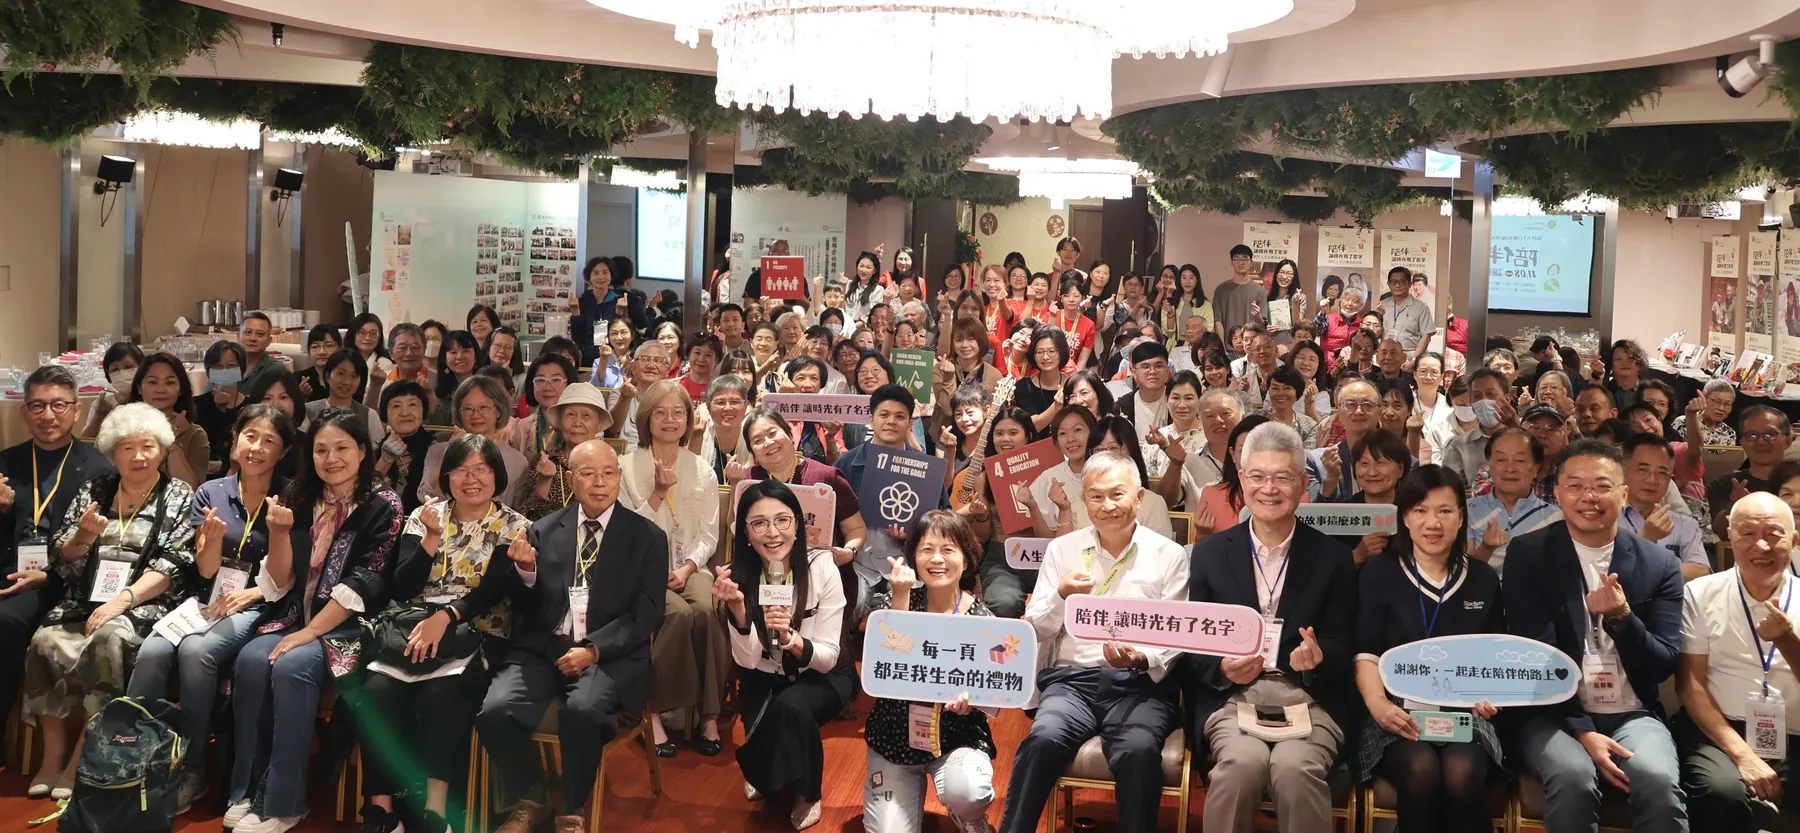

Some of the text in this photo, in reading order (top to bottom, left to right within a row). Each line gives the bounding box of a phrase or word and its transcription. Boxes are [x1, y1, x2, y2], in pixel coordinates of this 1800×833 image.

[1253, 239, 1271, 248] 陪伴
[1328, 243, 1346, 253] 陪伴
[1391, 247, 1409, 257] 陪伴
[765, 260, 769, 269] 1
[780, 403, 870, 415] 陪伴 讓時光有了名字
[877, 453, 929, 470] 17 PARTNERSHIPS
[994, 452, 1029, 477] 4 QUALITY
[1009, 458, 1040, 474] EDUCATION
[890, 465, 926, 478] FOR THE GOALS
[1020, 549, 1044, 563] 人生
[1075, 608, 1235, 636] 陪伴 讓時光有了名字
[921, 640, 976, 661] 每一頁
[873, 661, 1023, 691] 都是我生命的禮物
